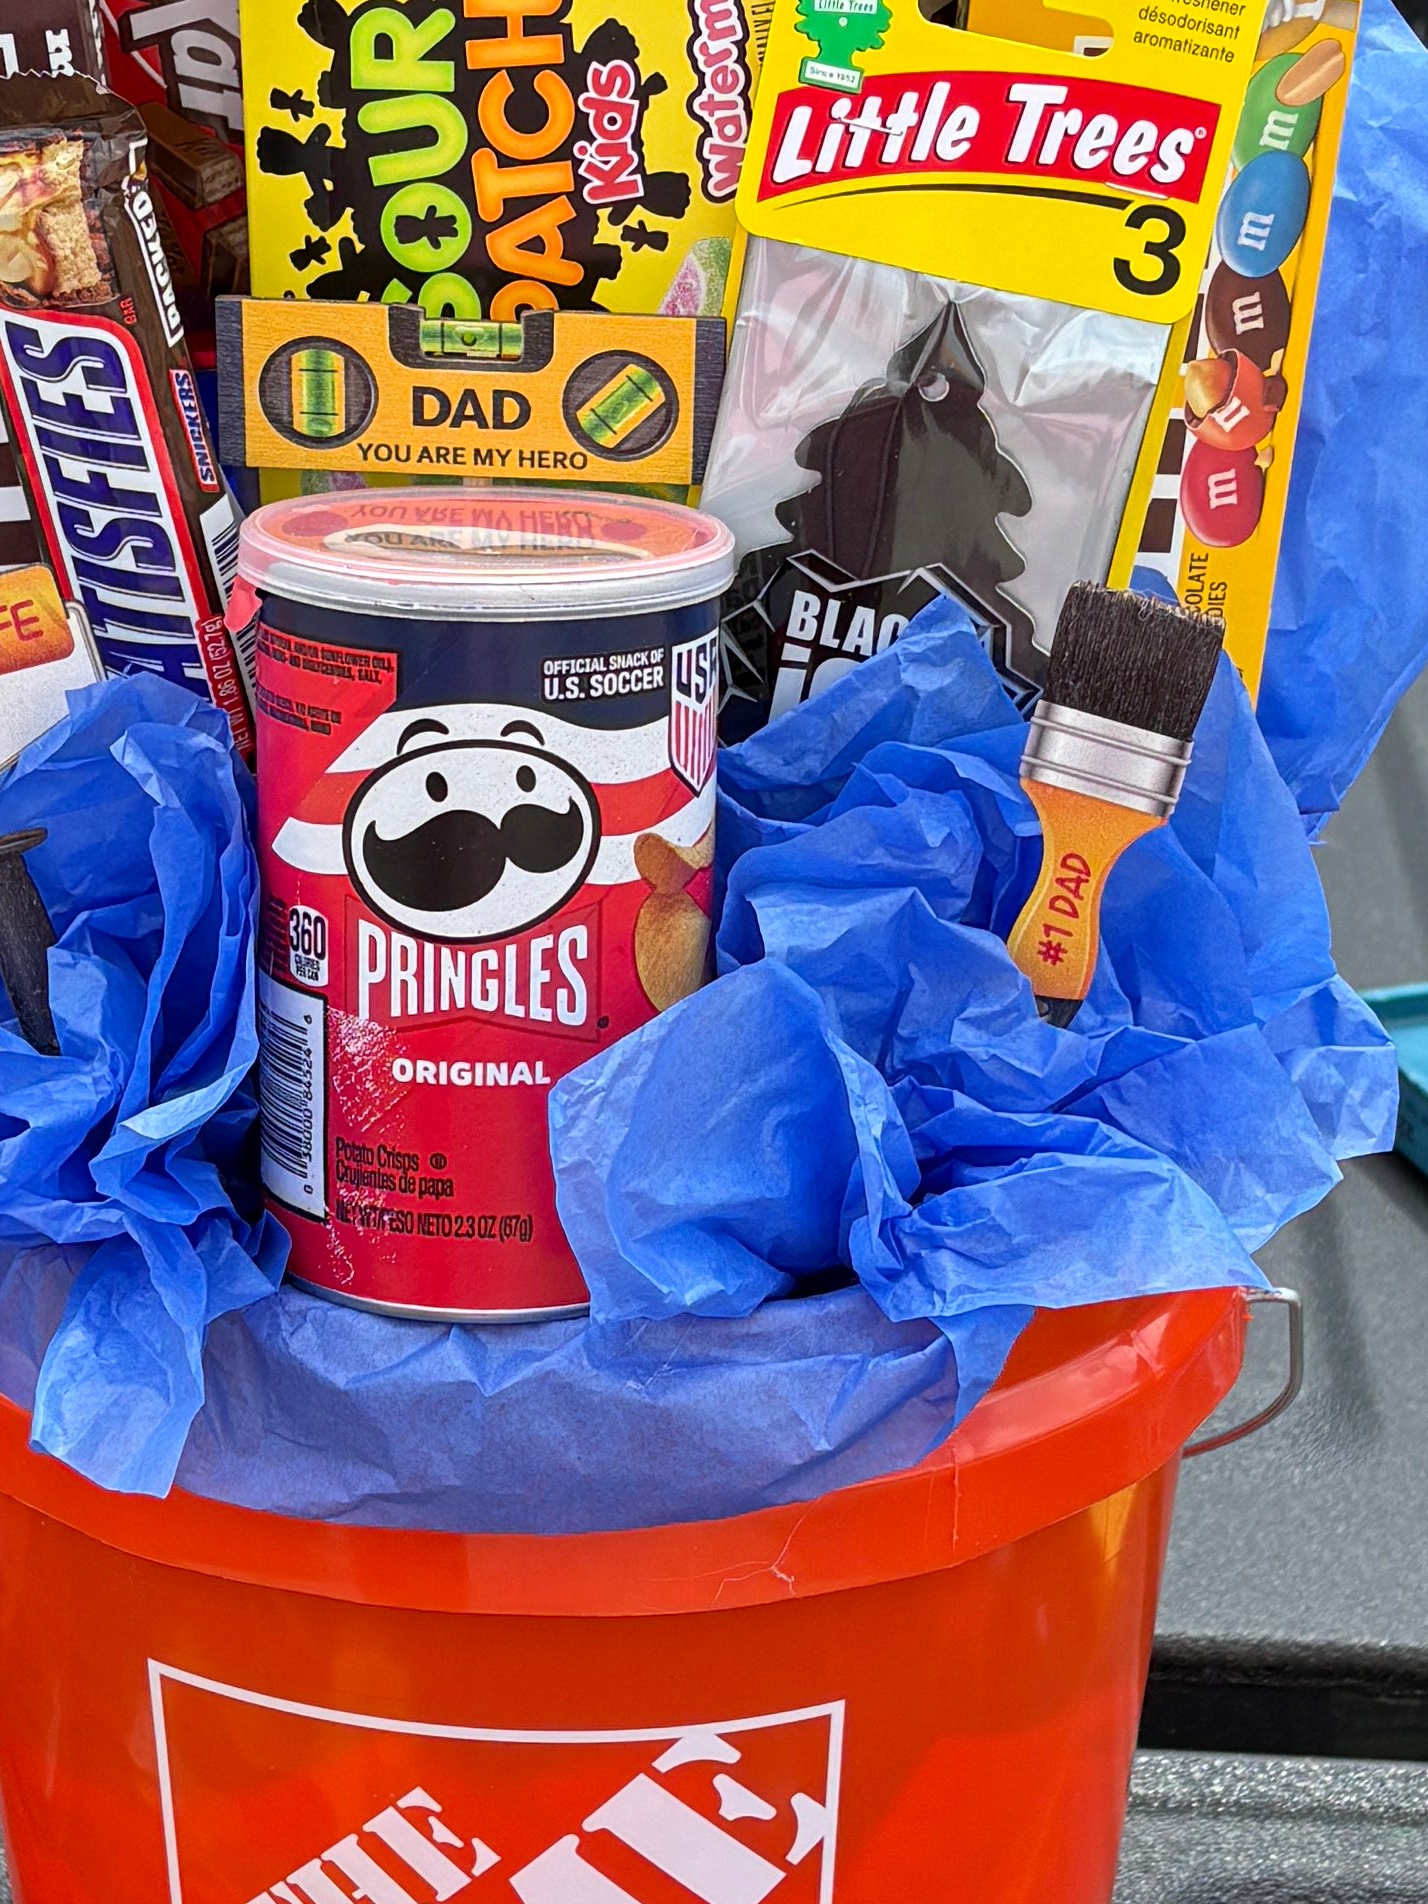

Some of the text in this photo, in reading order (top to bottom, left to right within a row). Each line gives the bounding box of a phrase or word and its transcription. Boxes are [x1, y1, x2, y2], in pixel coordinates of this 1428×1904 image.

[1138, 4, 1241, 40] désodorisant
[1133, 29, 1236, 63] aromatizante
[577, 61, 644, 204] Kids
[771, 80, 1196, 185] Little Trees
[1113, 203, 1187, 296] 3
[174, 371, 217, 482] SNICKERS
[411, 385, 532, 431] DAD
[357, 442, 588, 471] YOU ARE MY HERO
[5, 320, 209, 703] ATISFIES
[1184, 553, 1209, 613] OLATE
[201, 614, 230, 661] (52.7g)
[785, 589, 914, 657] BLAC
[212, 661, 233, 679] OZ
[543, 648, 664, 676] OFFICIAL SNACK OF
[543, 667, 664, 701] U.S. SOCCER
[218, 679, 240, 705] 1.86
[1037, 851, 1091, 967] #1 DAD
[289, 908, 328, 961] 360
[357, 918, 588, 1027] PRINGLES
[392, 1057, 551, 1086] ORIGINAL
[336, 1137, 420, 1175] Potato Crisps
[399, 1173, 416, 1195] de
[419, 1177, 454, 1200] papa
[417, 1212, 532, 1243] NETO 2.3 OZ (67g)
